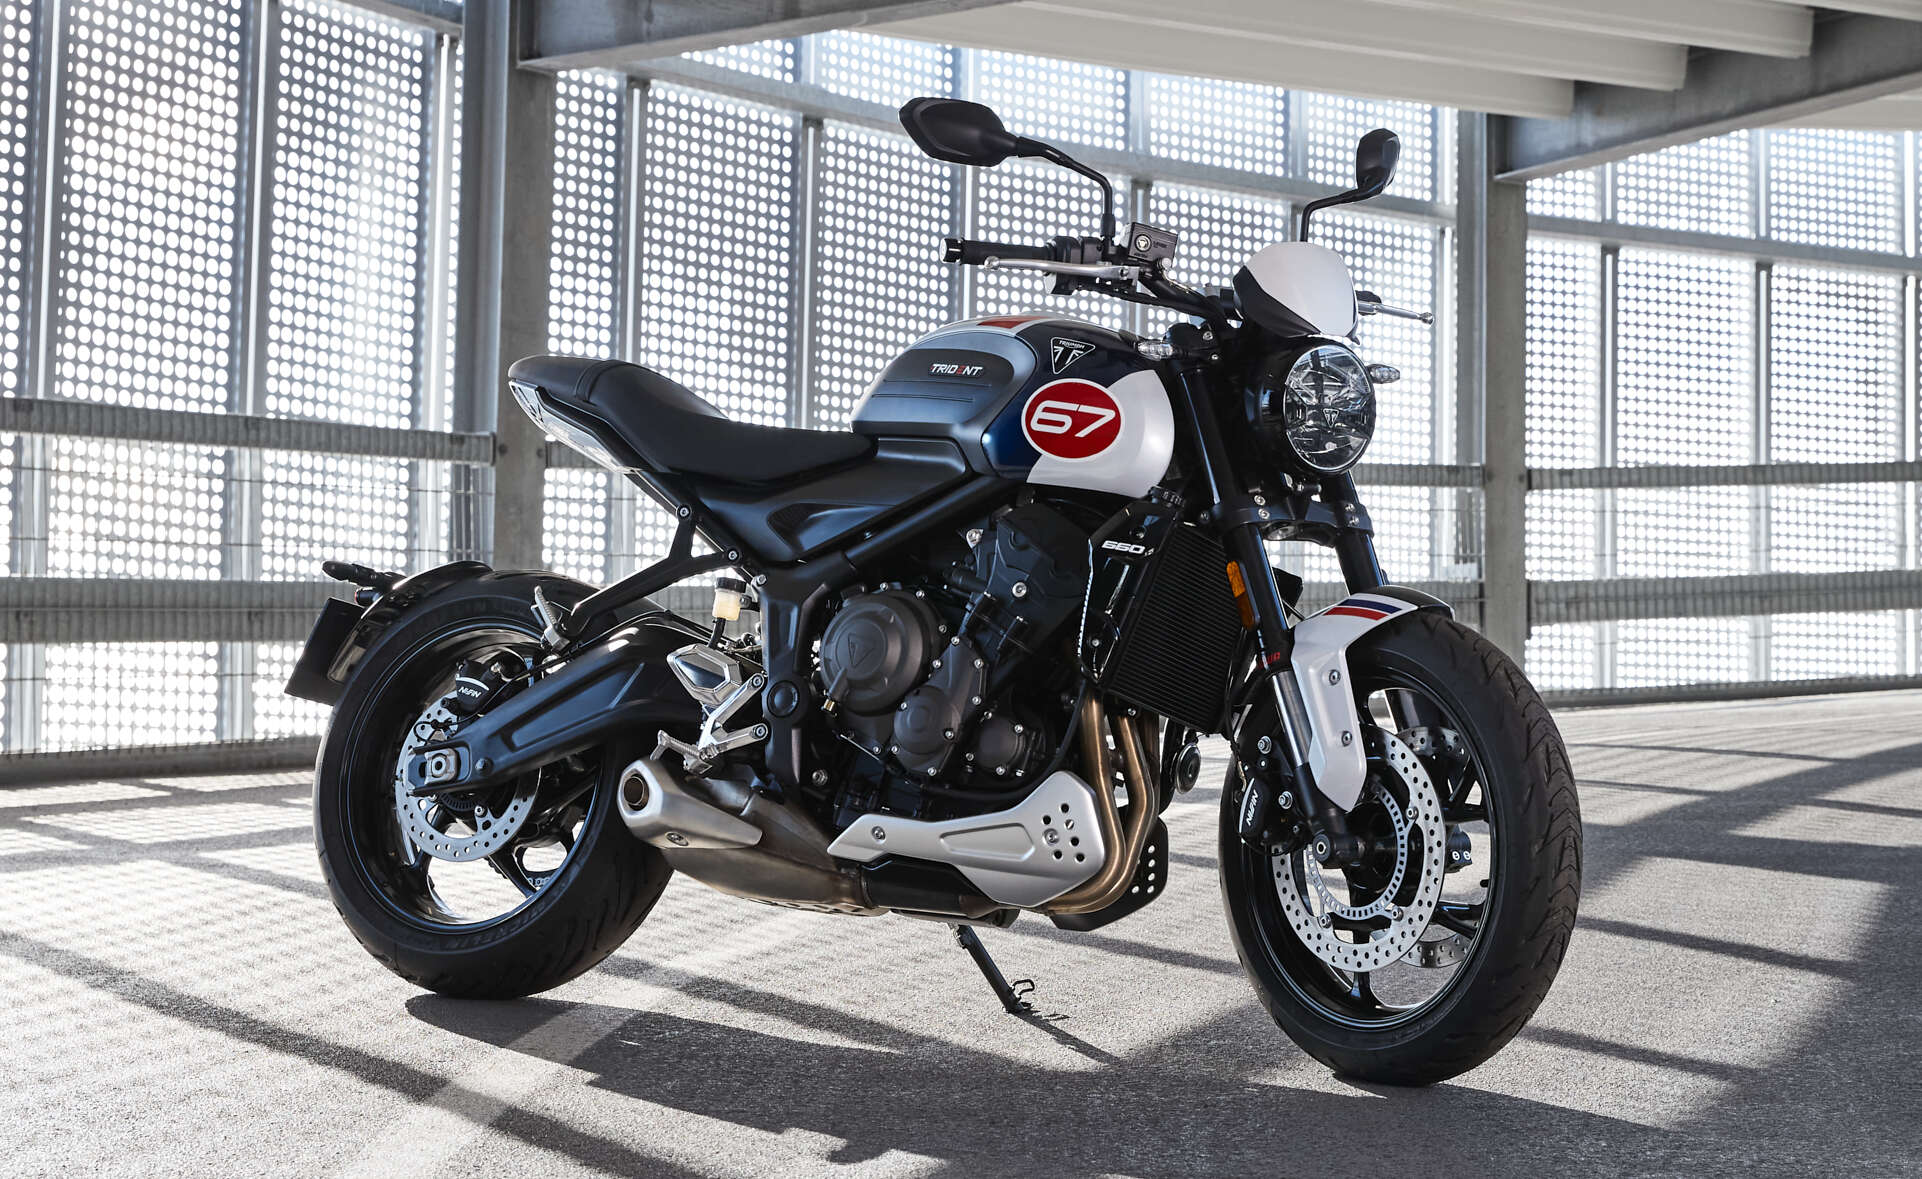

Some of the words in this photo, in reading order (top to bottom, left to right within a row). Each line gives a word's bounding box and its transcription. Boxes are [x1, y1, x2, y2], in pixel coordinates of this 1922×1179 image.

[930, 363, 983, 376] TRIDENT
[1030, 400, 1116, 438] 67
[1101, 540, 1146, 555] 660
